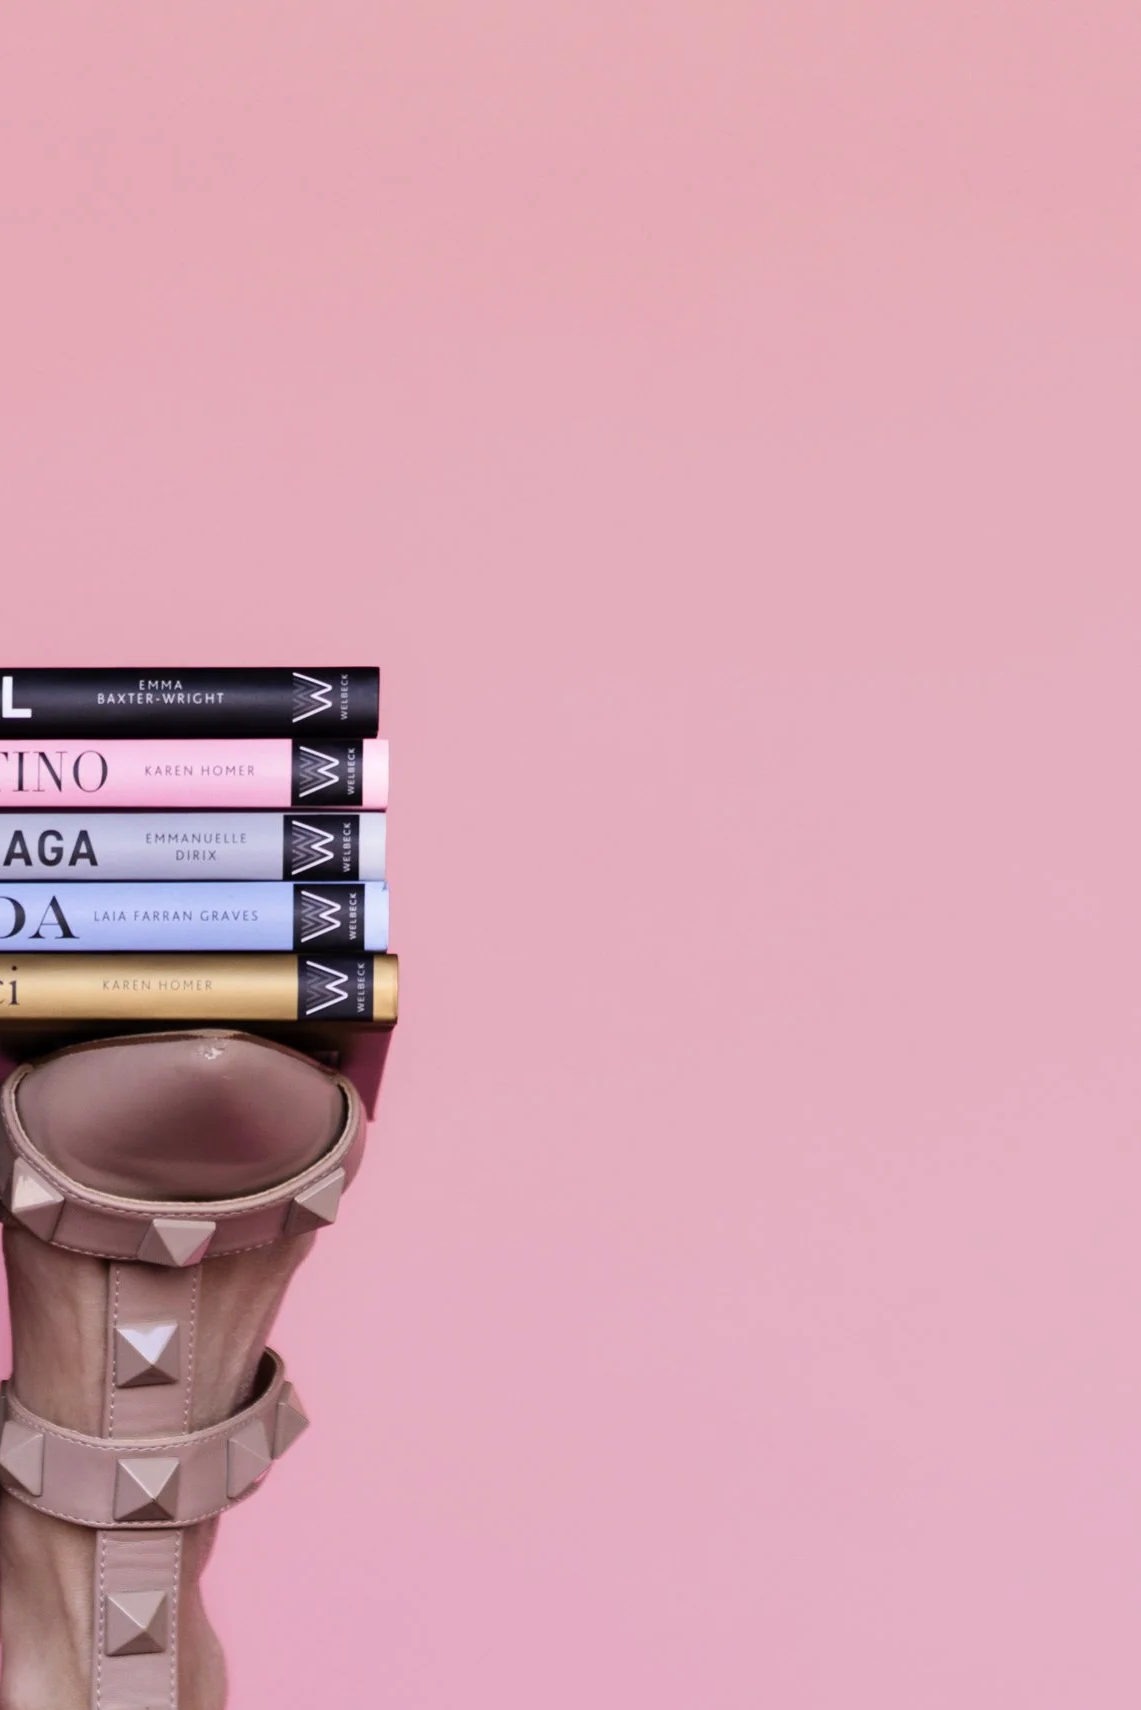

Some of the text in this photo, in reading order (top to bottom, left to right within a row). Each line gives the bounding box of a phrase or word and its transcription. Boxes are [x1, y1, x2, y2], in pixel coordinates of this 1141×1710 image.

[139, 680, 183, 690] EMMA
[97, 693, 225, 705] BAXTER-WRIGHT
[144, 765, 255, 776] KAREN HOMER
[347, 747, 355, 796] WELBECK
[145, 833, 247, 844] EMMANUELLE
[343, 822, 351, 872] WELBECK
[175, 850, 217, 861] DIRIX
[94, 910, 259, 921] LAIA FARRAN GRAVES
[349, 892, 357, 940] WELBECK
[103, 980, 213, 990] KAREN HOMER
[357, 962, 365, 1012] WELBECK
